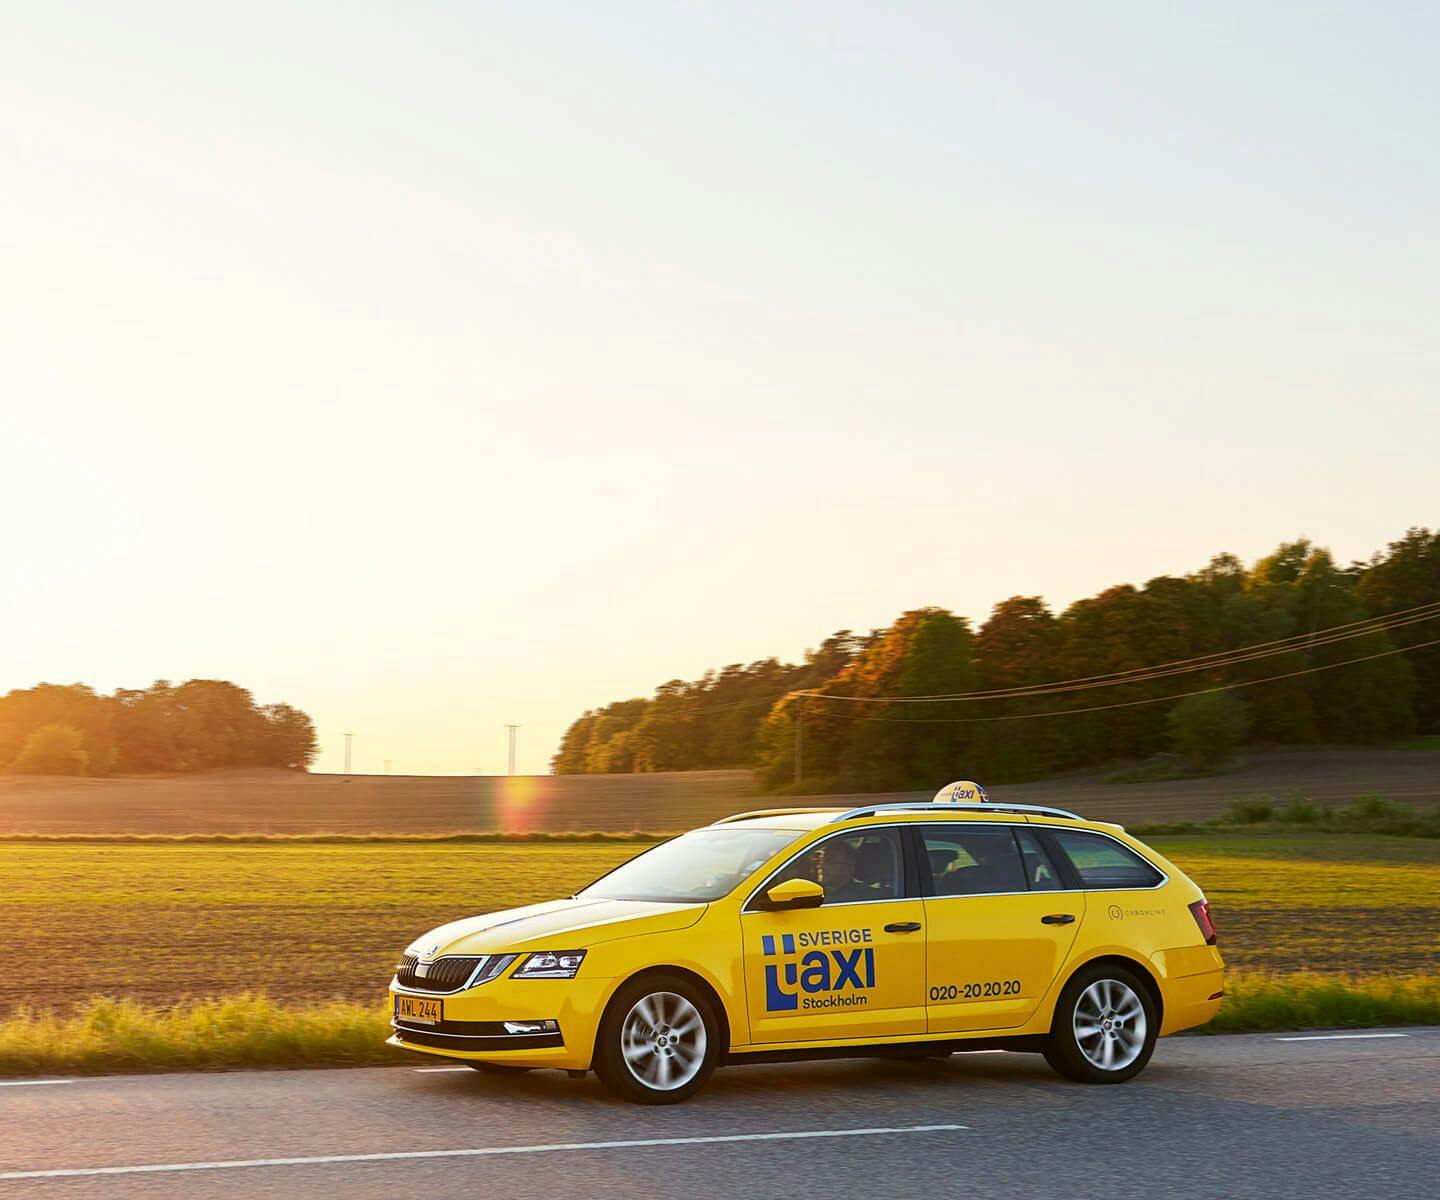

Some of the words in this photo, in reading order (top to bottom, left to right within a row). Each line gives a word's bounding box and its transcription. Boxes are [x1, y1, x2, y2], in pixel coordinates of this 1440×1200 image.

[799, 929, 872, 947] SVERIGE
[929, 983, 982, 1001] 020-20
[983, 982, 1002, 997] 20
[1003, 980, 1021, 995] 20
[401, 999, 417, 1017] AWL
[419, 1001, 438, 1019] 244
[802, 994, 867, 1009] Stockholm
